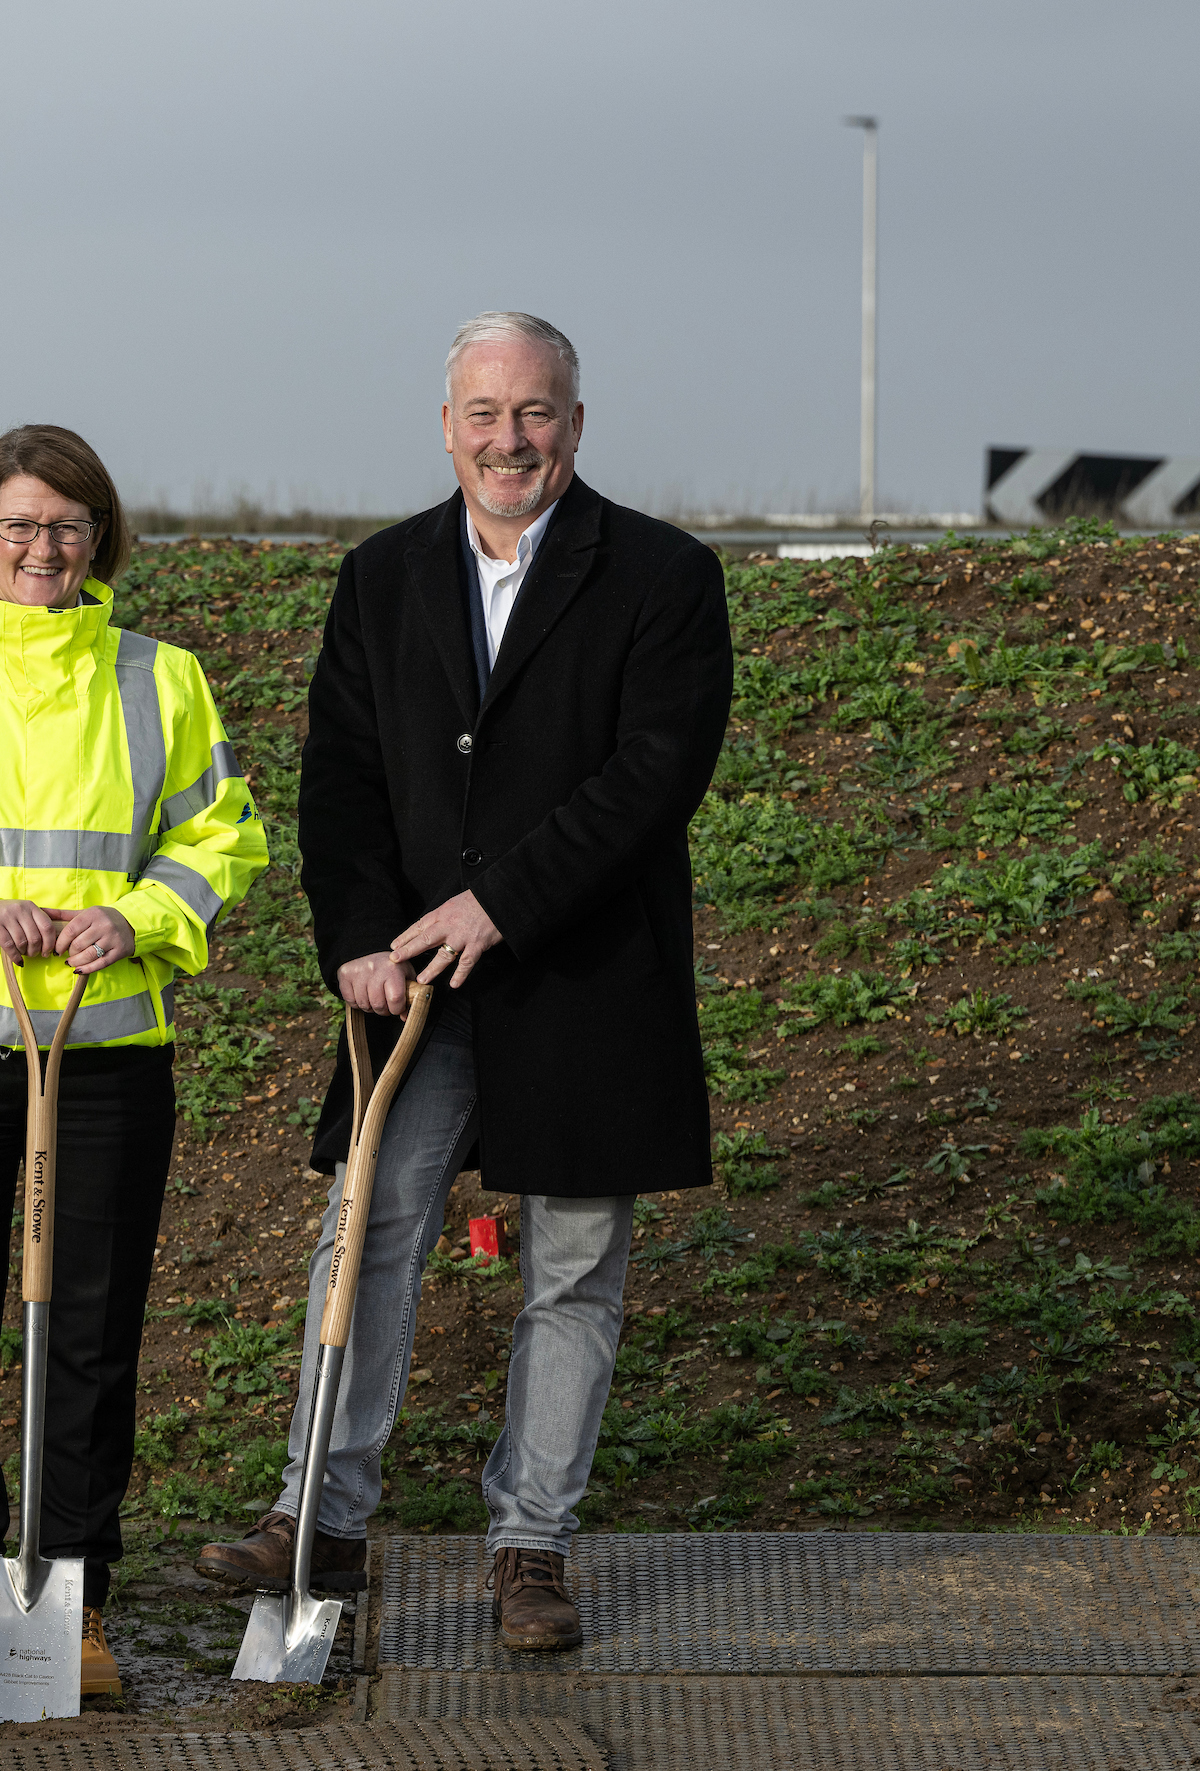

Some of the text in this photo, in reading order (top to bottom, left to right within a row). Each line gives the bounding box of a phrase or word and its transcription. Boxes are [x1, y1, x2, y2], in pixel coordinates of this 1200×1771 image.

[31, 1150, 48, 1244] Kent & Stowe
[329, 1198, 354, 1289] Kent & Stowe
[64, 1578, 74, 1601] Kent
[63, 1608, 73, 1636] Stowe
[19, 1654, 52, 1662] highways
